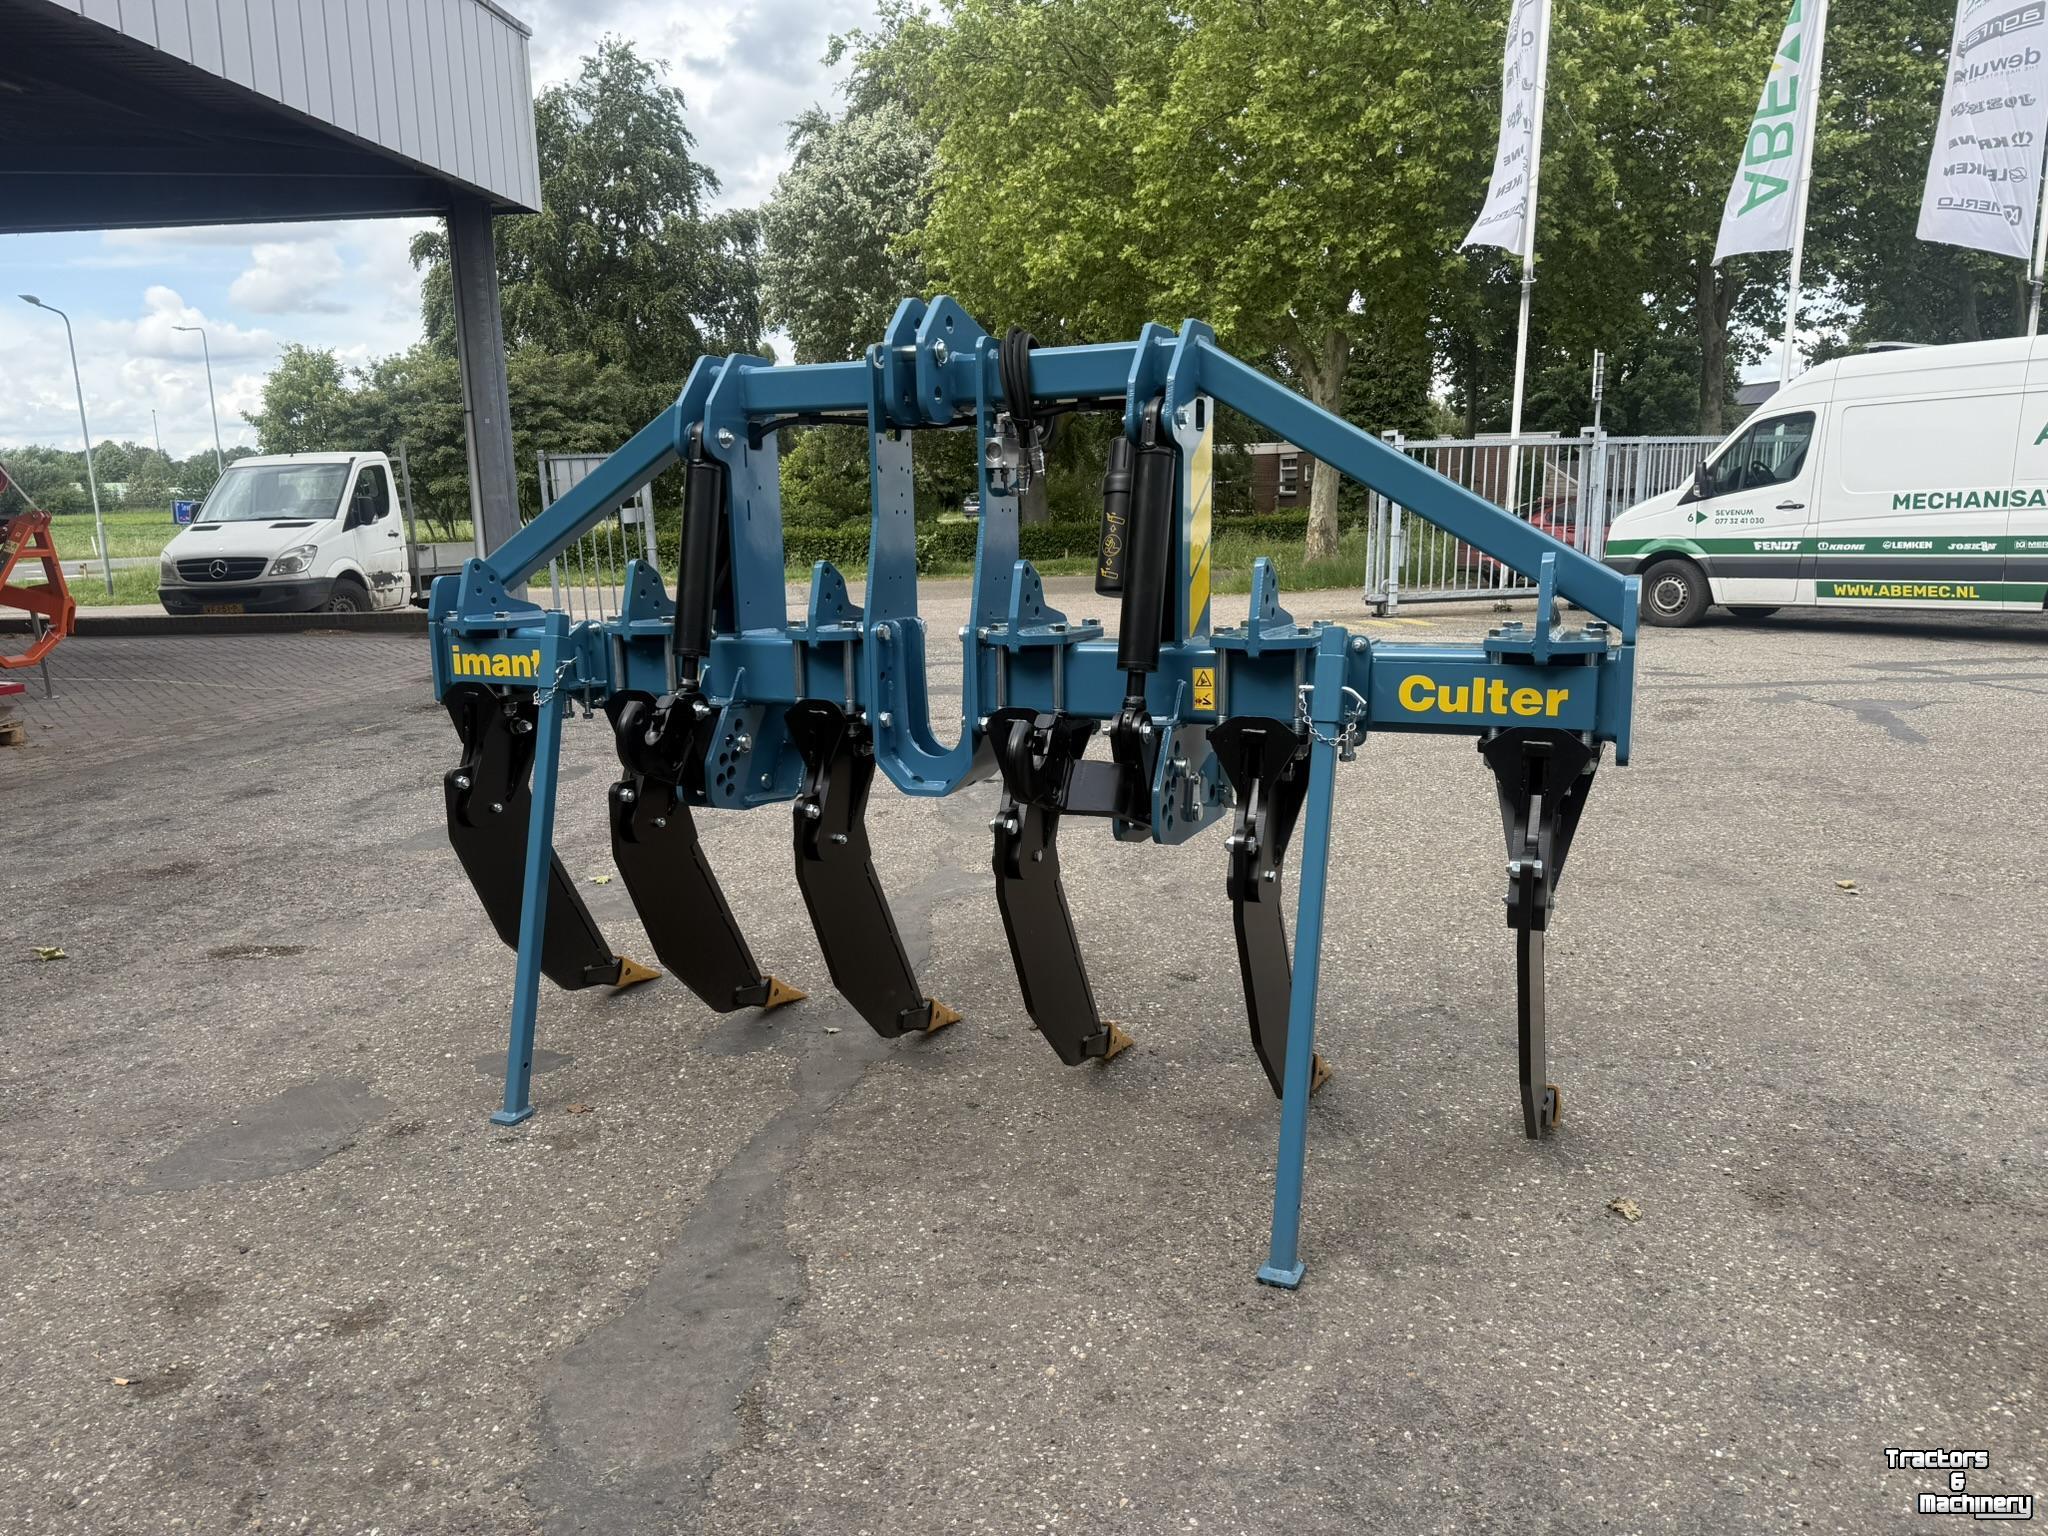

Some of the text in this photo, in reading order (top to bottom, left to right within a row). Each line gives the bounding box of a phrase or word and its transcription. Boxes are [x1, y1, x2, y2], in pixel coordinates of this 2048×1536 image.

[1892, 489, 2048, 510] MECHANISA
[1687, 513, 1694, 522] 6
[1753, 541, 1802, 551] FENDT
[1829, 543, 1866, 551] KRONE
[1891, 541, 1933, 550] LEMKEN
[1834, 584, 1980, 598] WWW.ABEMEC.NL
[1398, 674, 1569, 717] Culter
